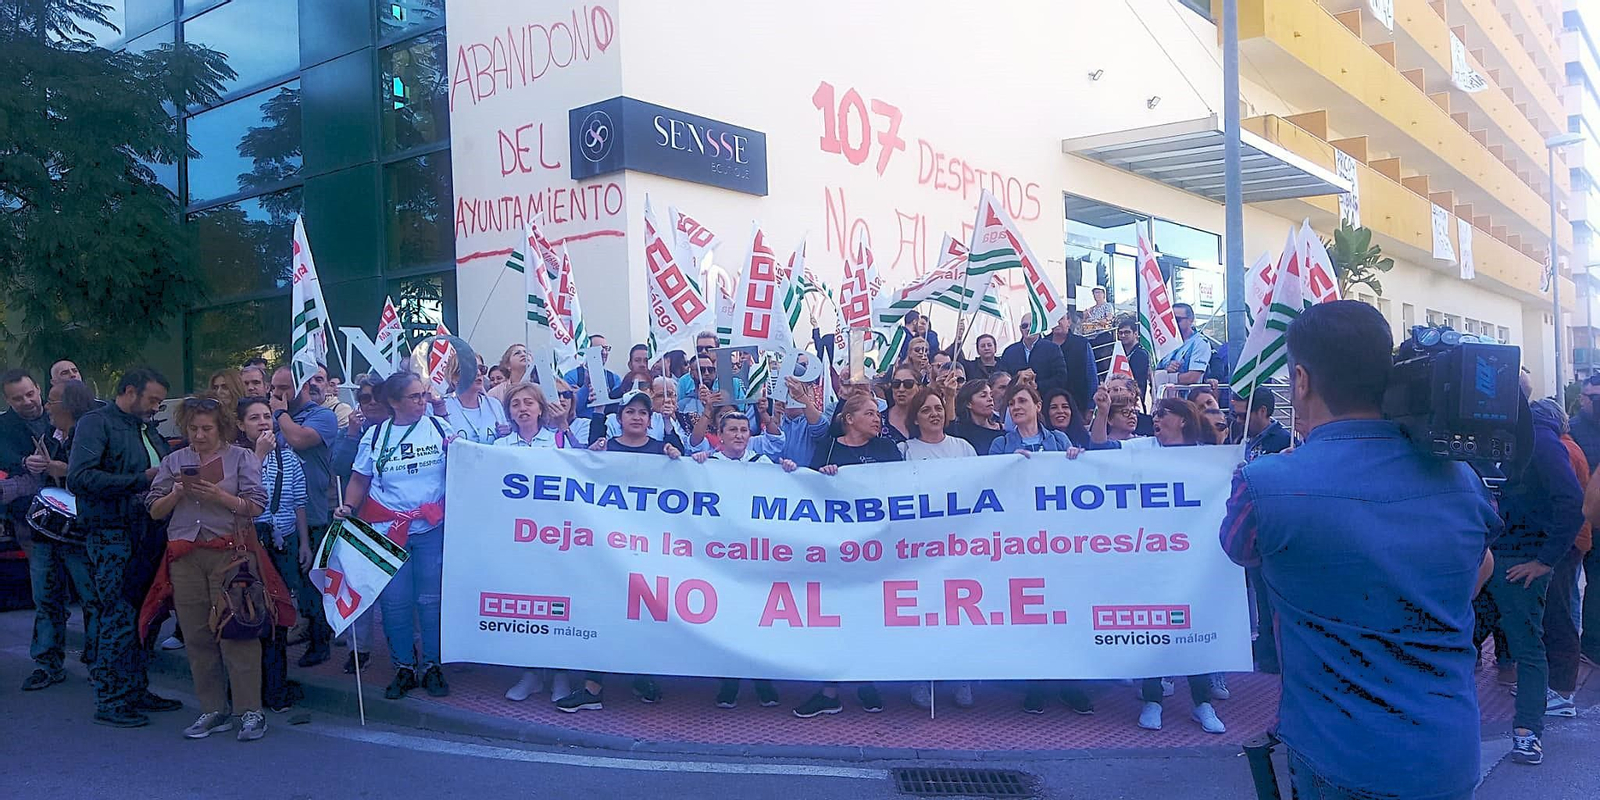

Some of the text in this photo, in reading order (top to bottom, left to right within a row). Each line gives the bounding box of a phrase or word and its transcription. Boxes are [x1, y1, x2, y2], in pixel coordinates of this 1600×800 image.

[450, 5, 614, 112] ABANDONO
[498, 123, 560, 177] DEL
[654, 115, 750, 165] SENSSE
[812, 81, 906, 177] 107
[501, 472, 1201, 524] SENATOR MARBELLA HOTEL
[514, 518, 1191, 563] Deja en la calle a 90 trabajadores/as
[626, 572, 1068, 628] NO AL E.R.E.
[479, 619, 597, 640] servicios málaga
[1094, 630, 1218, 646] servicios málaga
